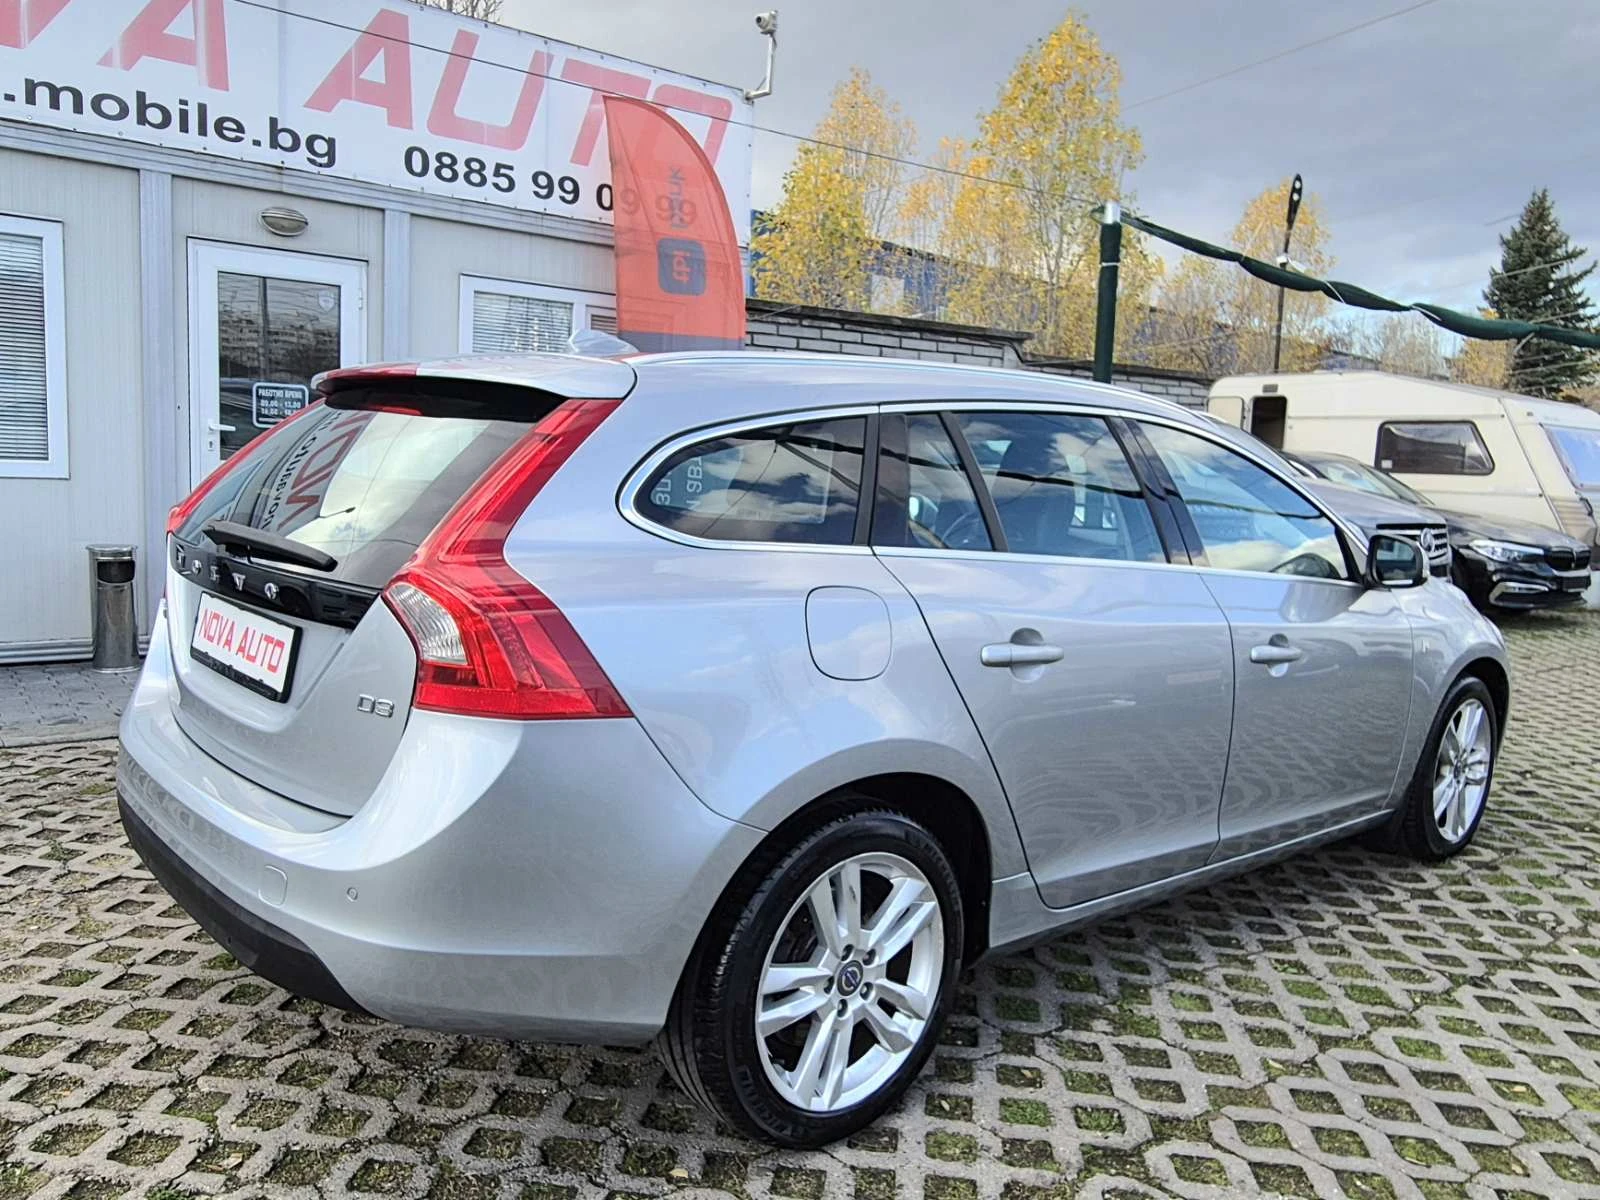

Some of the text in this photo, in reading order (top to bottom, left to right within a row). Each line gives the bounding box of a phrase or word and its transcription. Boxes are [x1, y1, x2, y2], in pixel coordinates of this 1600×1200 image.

[404, 145, 516, 193] 0885
[532, 170, 580, 205] 99
[200, 608, 285, 673] NOVA AUTO
[357, 694, 394, 718] D3
